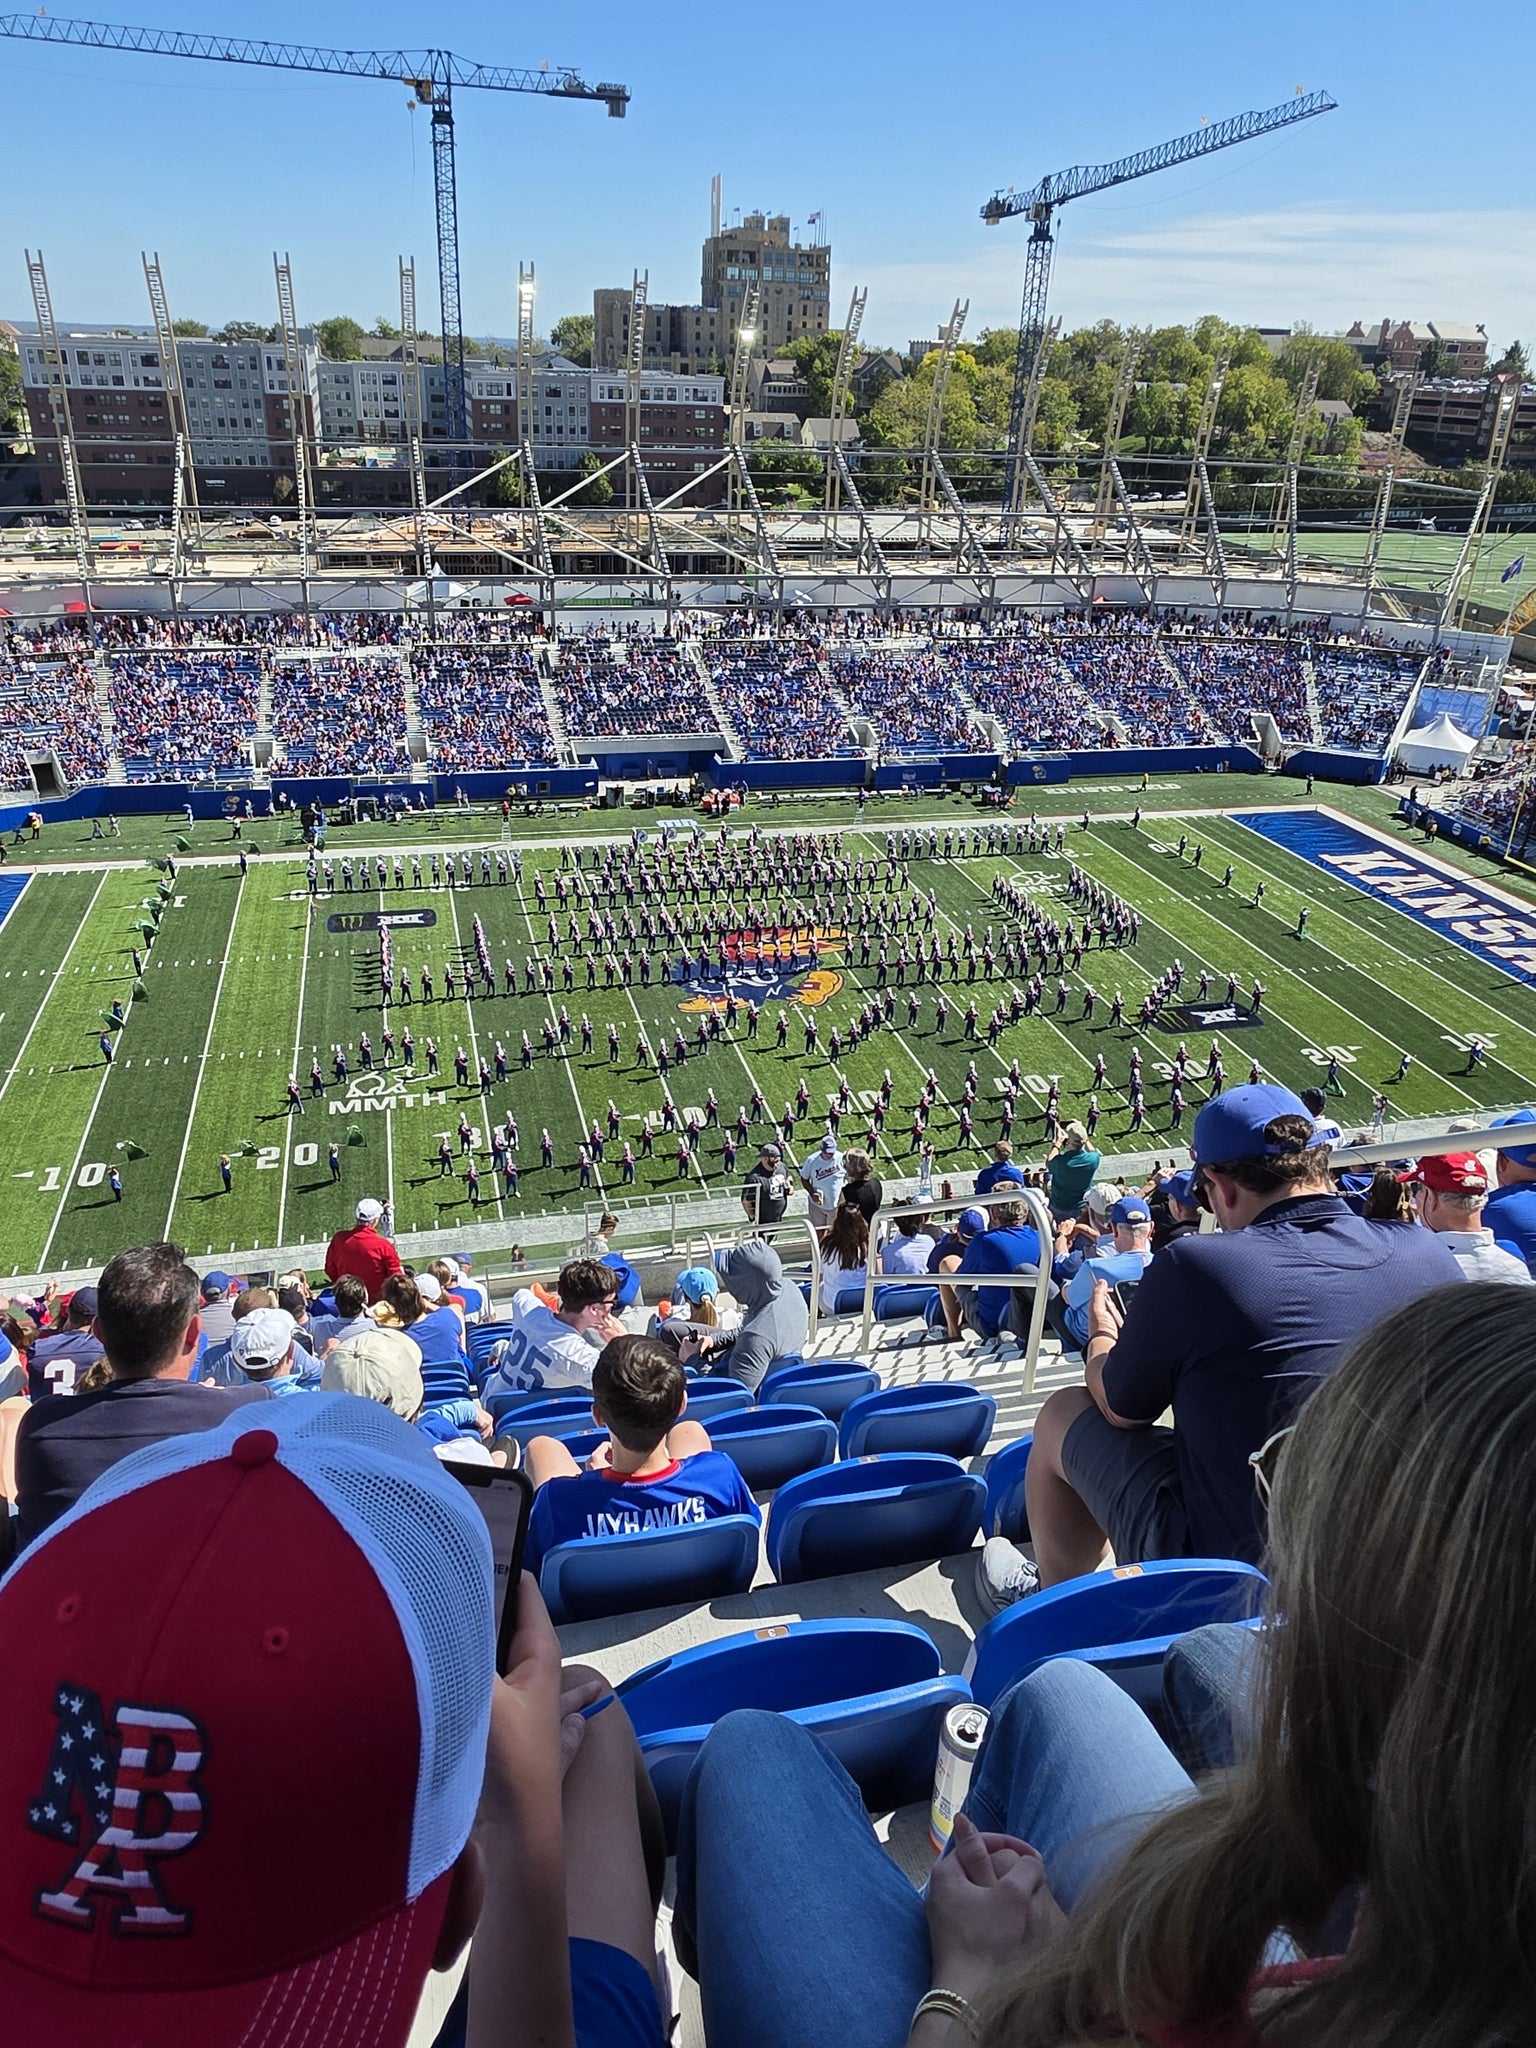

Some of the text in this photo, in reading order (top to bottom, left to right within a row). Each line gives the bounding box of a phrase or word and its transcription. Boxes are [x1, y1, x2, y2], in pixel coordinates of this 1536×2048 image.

[1300, 1045, 1358, 1066] 20
[328, 1091, 447, 1115] MMTH
[256, 1143, 319, 1170] 20
[37, 1162, 107, 1192] 10
[500, 1329, 553, 1390] 25
[43, 1358, 76, 1396] 3
[582, 1496, 708, 1539] JAYHAWKS
